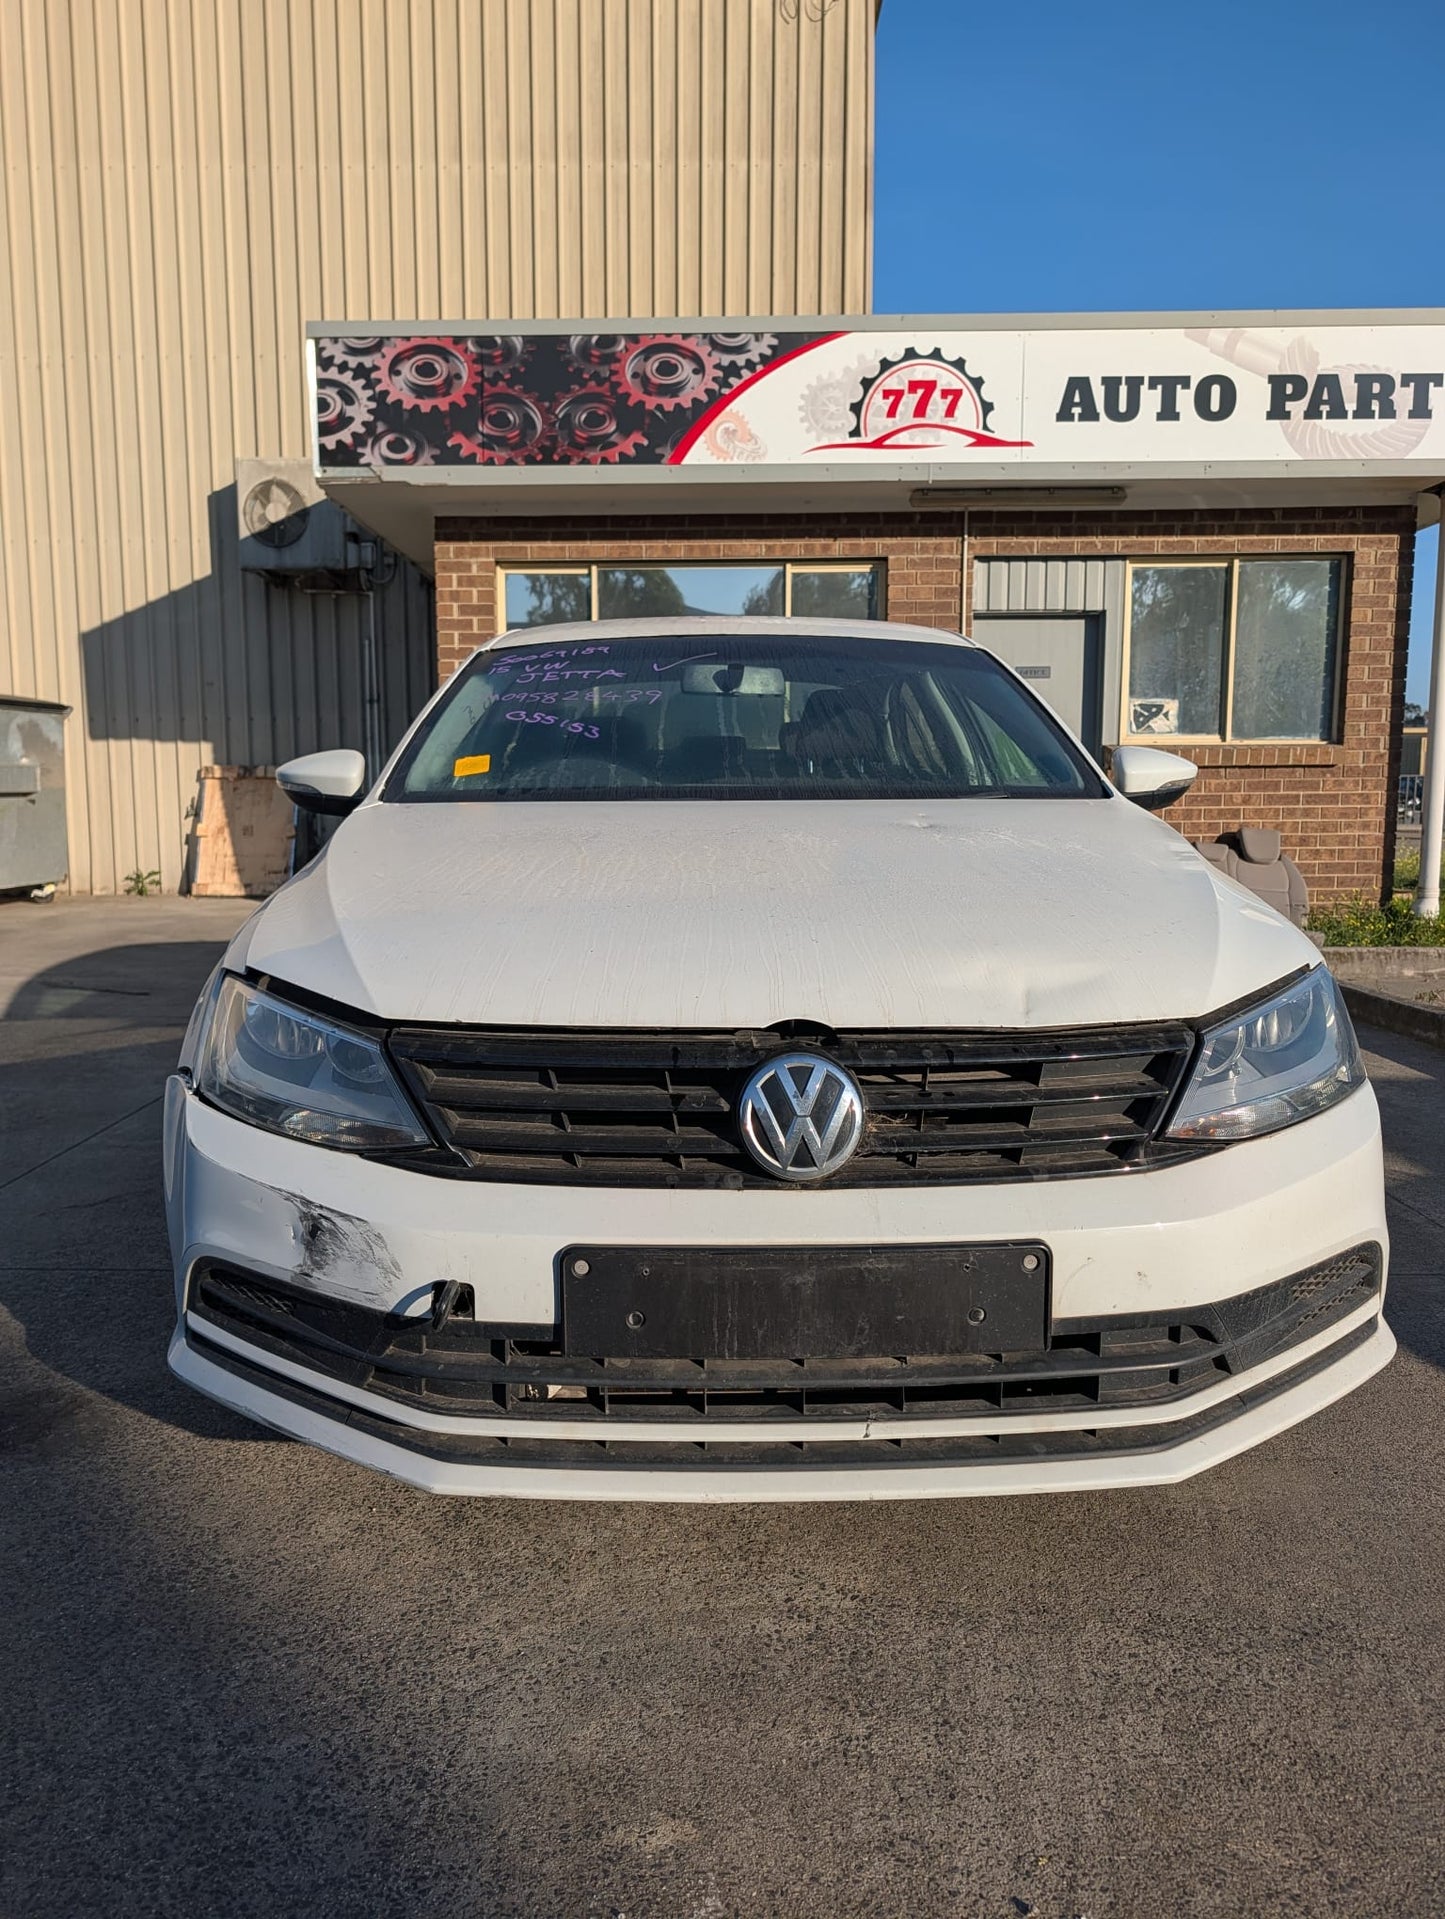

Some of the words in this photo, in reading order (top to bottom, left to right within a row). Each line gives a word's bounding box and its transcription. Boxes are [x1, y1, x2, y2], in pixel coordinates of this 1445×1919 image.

[882, 380, 963, 419] 777
[1056, 375, 1237, 422] AUTO
[1266, 373, 1443, 420] PART
[515, 669, 628, 684] JETTA
[525, 660, 571, 673] VW
[743, 1056, 860, 1177] VW
